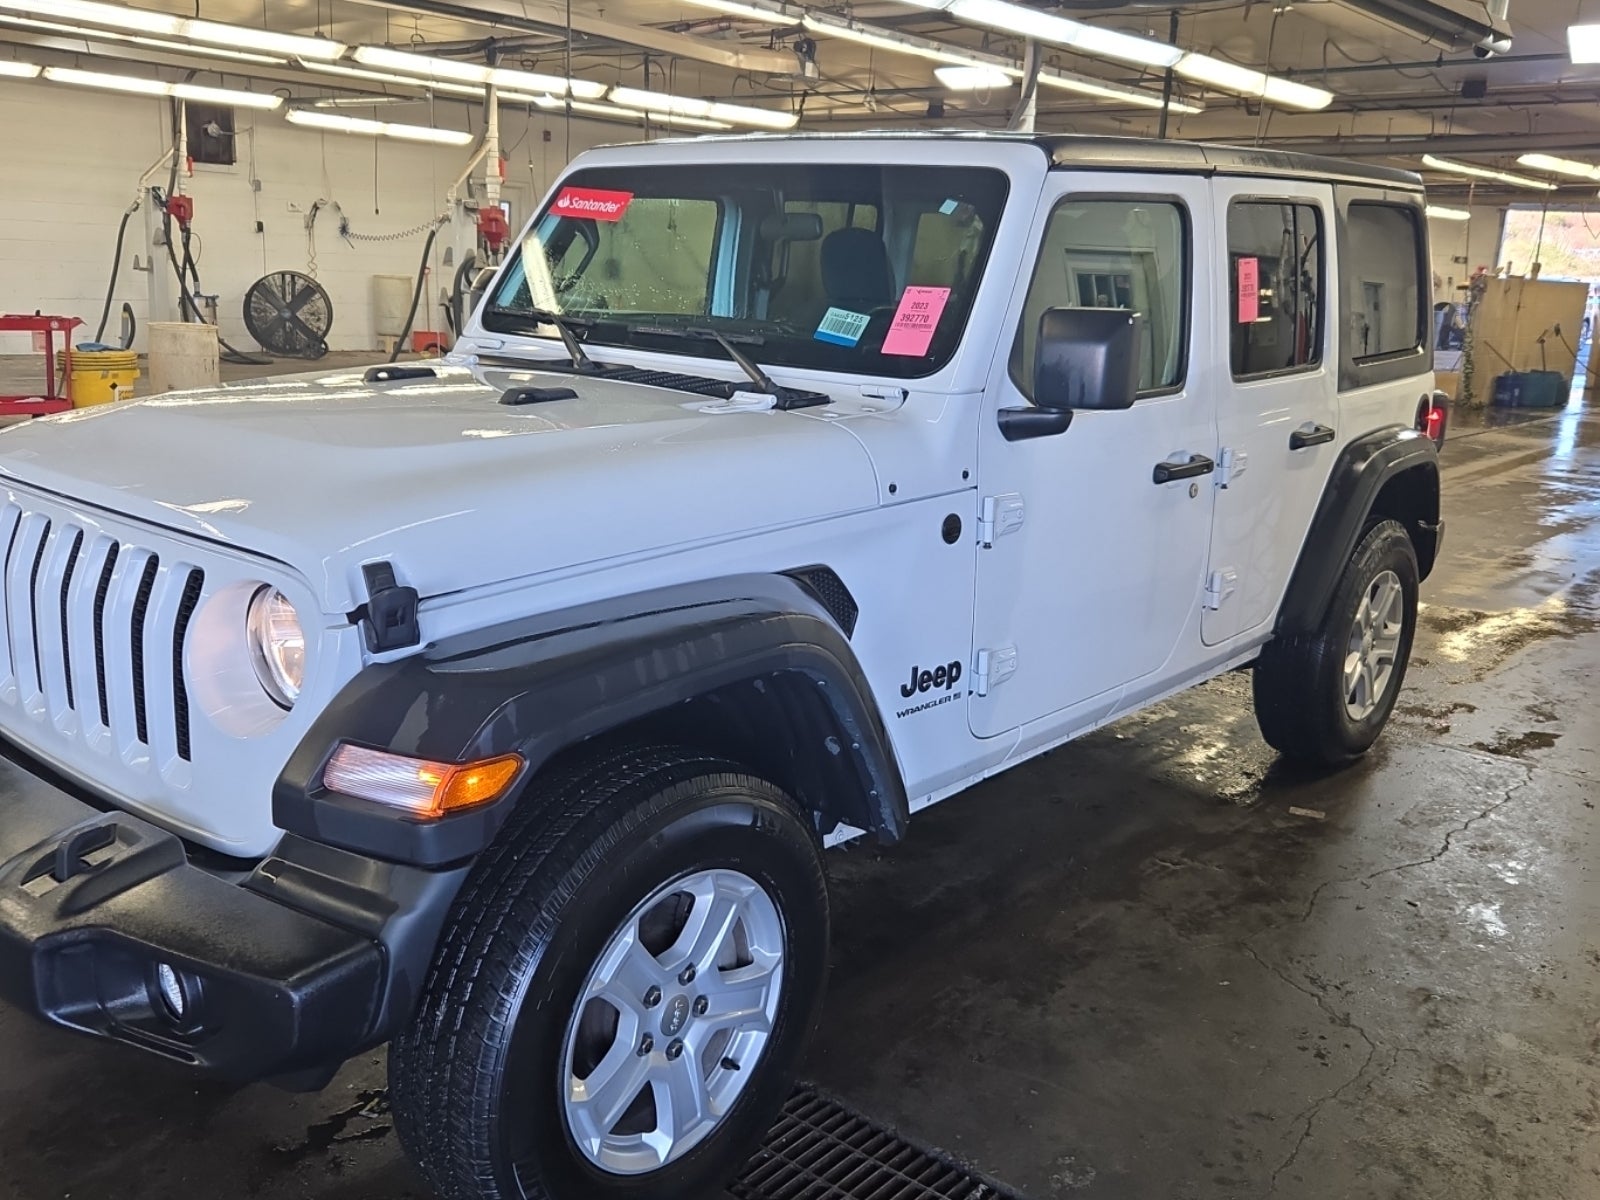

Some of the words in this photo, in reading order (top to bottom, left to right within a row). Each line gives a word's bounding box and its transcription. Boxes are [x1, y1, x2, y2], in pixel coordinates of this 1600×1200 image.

[569, 196, 621, 213] Santander
[911, 302, 930, 310] 2023
[900, 313, 930, 323] 392770
[900, 660, 962, 698] Jeep
[896, 695, 952, 719] WRANGLER
